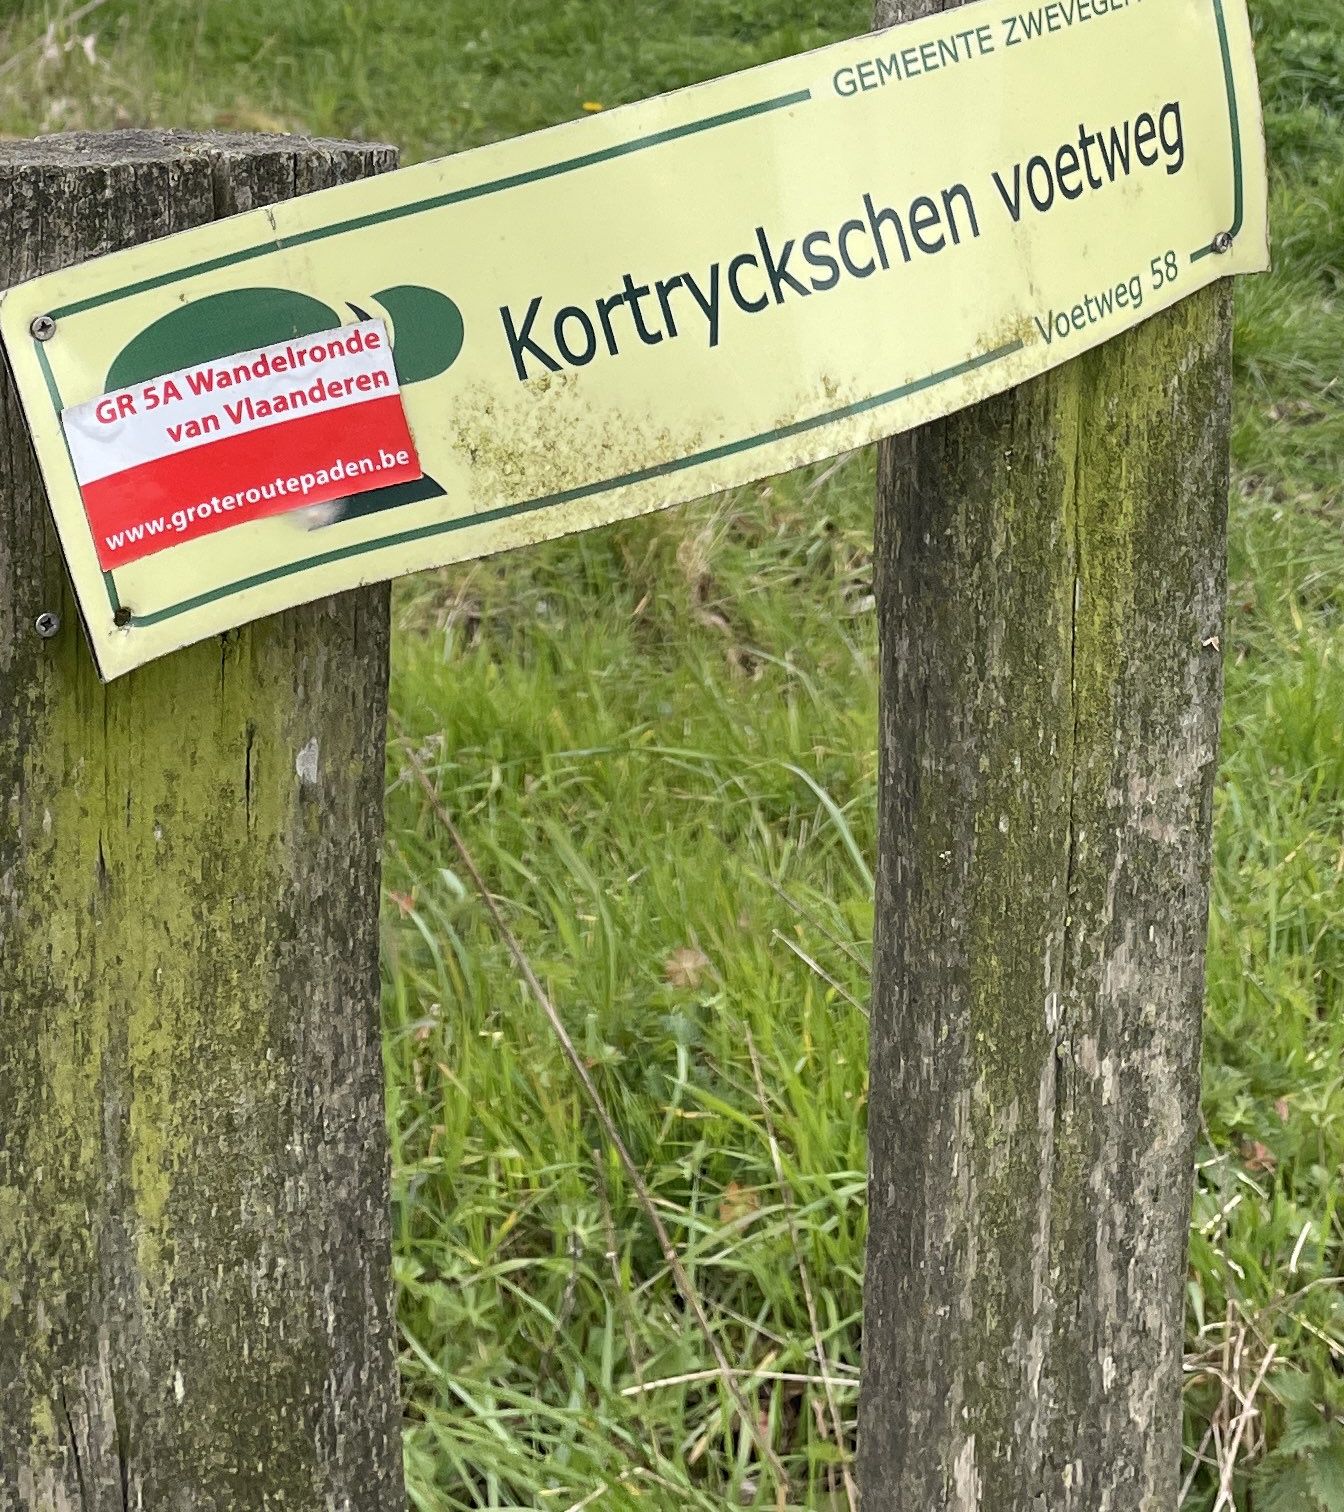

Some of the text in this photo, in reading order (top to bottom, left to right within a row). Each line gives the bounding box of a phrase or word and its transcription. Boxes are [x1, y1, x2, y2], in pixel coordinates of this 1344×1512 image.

[832, 25, 995, 97] GEMEENTE
[499, 100, 1186, 382] Kortryckschen voetweg
[1034, 249, 1179, 346] Voetweg 58
[95, 328, 382, 425] GR 5A Wandelronde
[166, 368, 390, 444] van Vlaanderen
[105, 449, 410, 551] www.groteroutepaden.be
